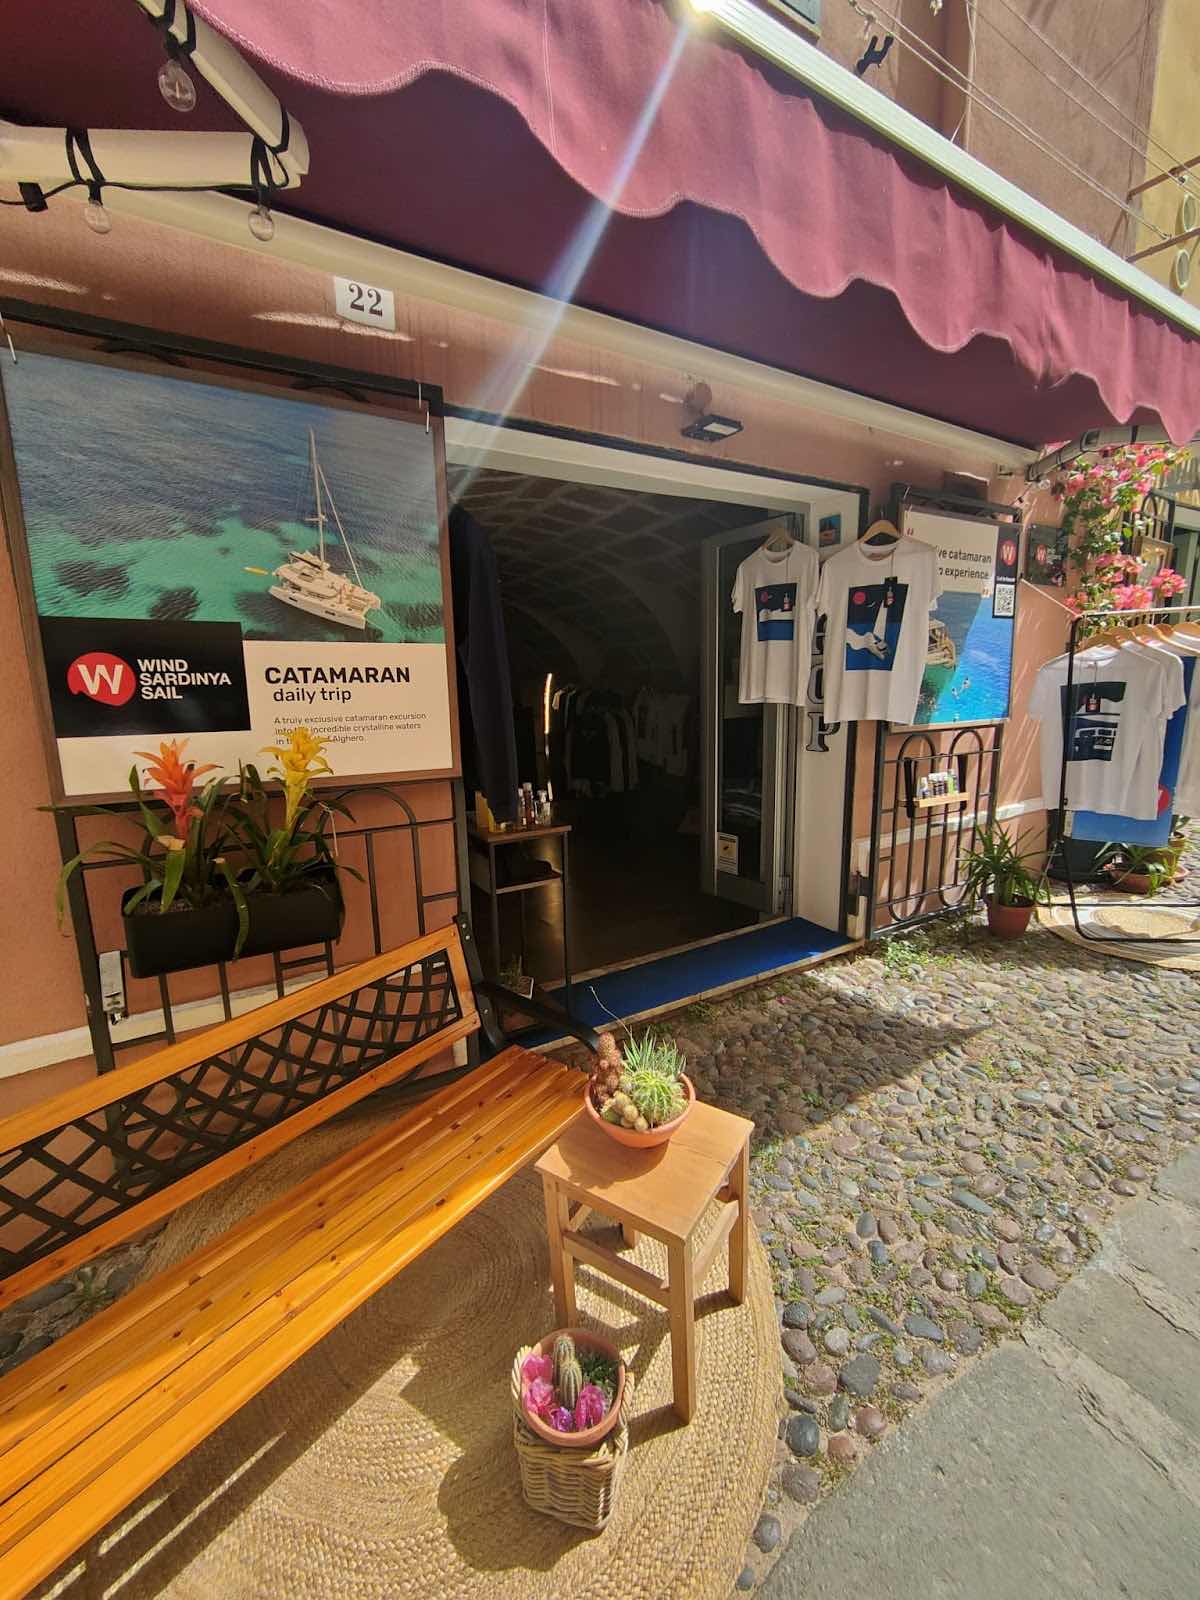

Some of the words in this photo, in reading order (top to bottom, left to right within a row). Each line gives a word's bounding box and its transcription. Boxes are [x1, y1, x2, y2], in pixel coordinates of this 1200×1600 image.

[349, 283, 383, 317] 22
[949, 549, 992, 563] catamaran
[945, 567, 989, 580] experience
[137, 659, 188, 672] WIND
[77, 664, 124, 695] W
[139, 672, 232, 686] SARDINYA
[264, 667, 410, 684] CATAMARAN
[141, 686, 183, 700] SAIL
[273, 688, 316, 704] daily
[320, 687, 352, 703] trip
[282, 717, 303, 725] truly
[304, 715, 343, 723] exclusive
[345, 713, 387, 722] catamaran
[389, 712, 427, 721] excursion
[275, 727, 293, 735] into
[311, 724, 352, 733] incredible
[353, 722, 394, 732] crystalline
[395, 721, 421, 730] waters
[275, 737, 285, 745] in
